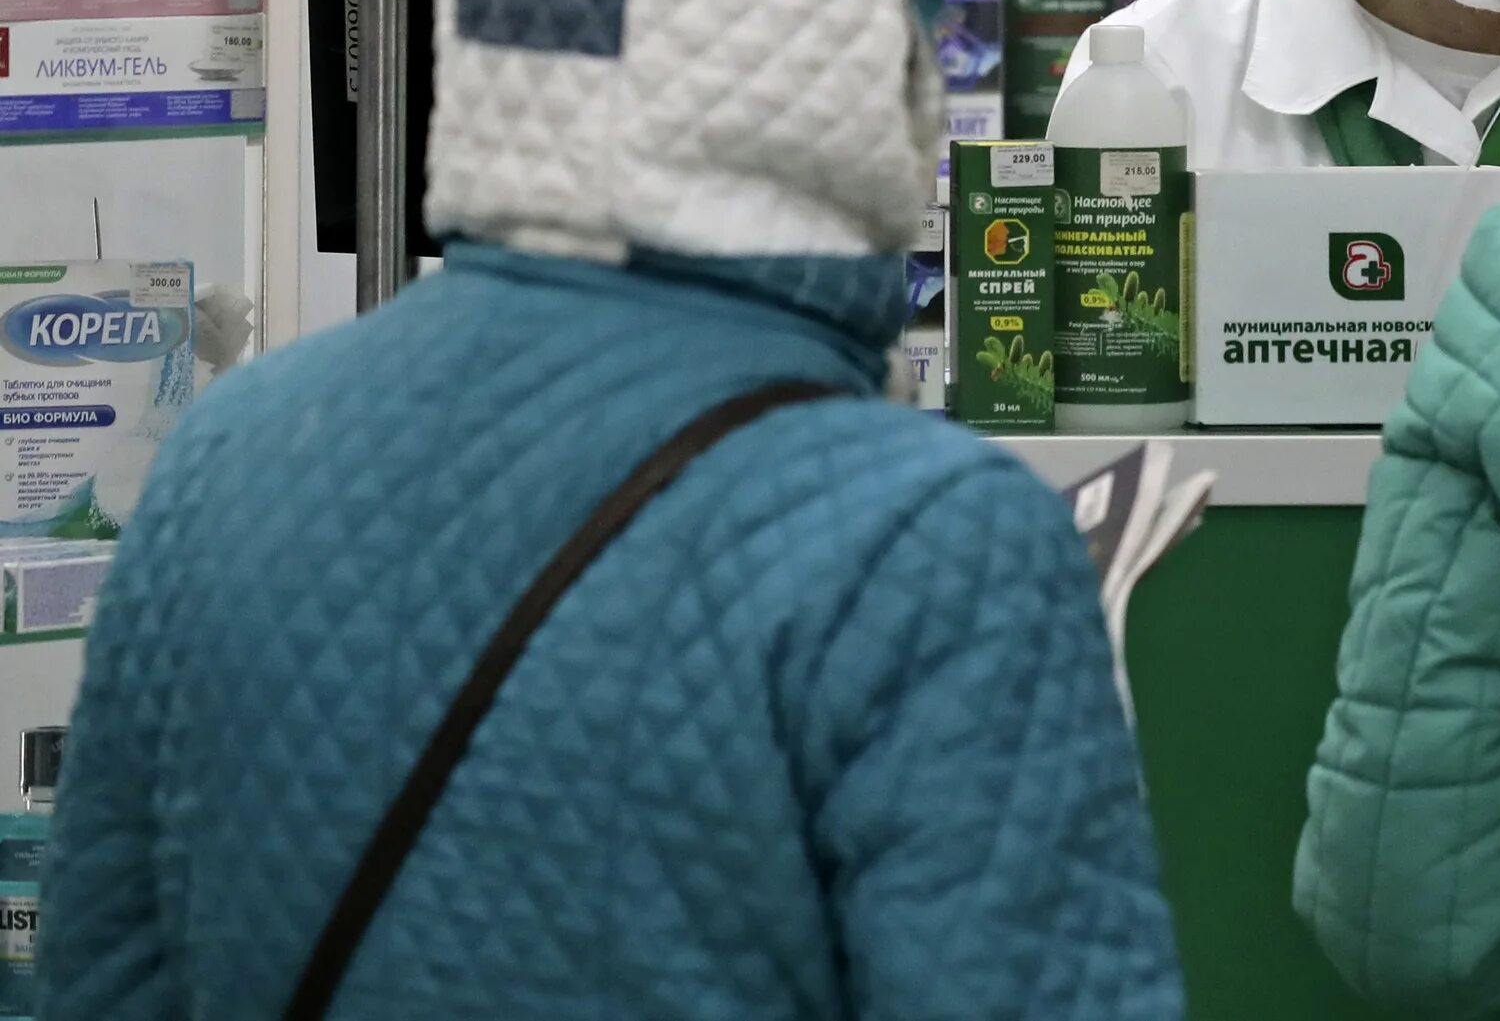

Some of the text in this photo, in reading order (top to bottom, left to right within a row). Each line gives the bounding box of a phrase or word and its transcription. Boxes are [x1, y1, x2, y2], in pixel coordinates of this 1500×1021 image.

[36, 57, 168, 79] ЛИКВУМ-ГЕЛЬ
[994, 196, 1042, 206] Настоящее
[1009, 206, 1045, 215] природы
[1074, 212, 1156, 227] от природы
[968, 269, 1046, 278] МИНЕРАЛЬНЫЙ
[979, 280, 1036, 294] СПРЕЙ
[29, 312, 161, 347] КОРЕГА
[1223, 321, 1435, 336] муниципальная новоси
[1223, 339, 1411, 365] аптечная
[1080, 374, 1096, 382] 500
[3, 379, 111, 391] Таблетки для очищения
[3, 391, 79, 402] зубных протезов
[993, 403, 1006, 412] 30
[3, 411, 97, 424] БИО ФОРМУЛА
